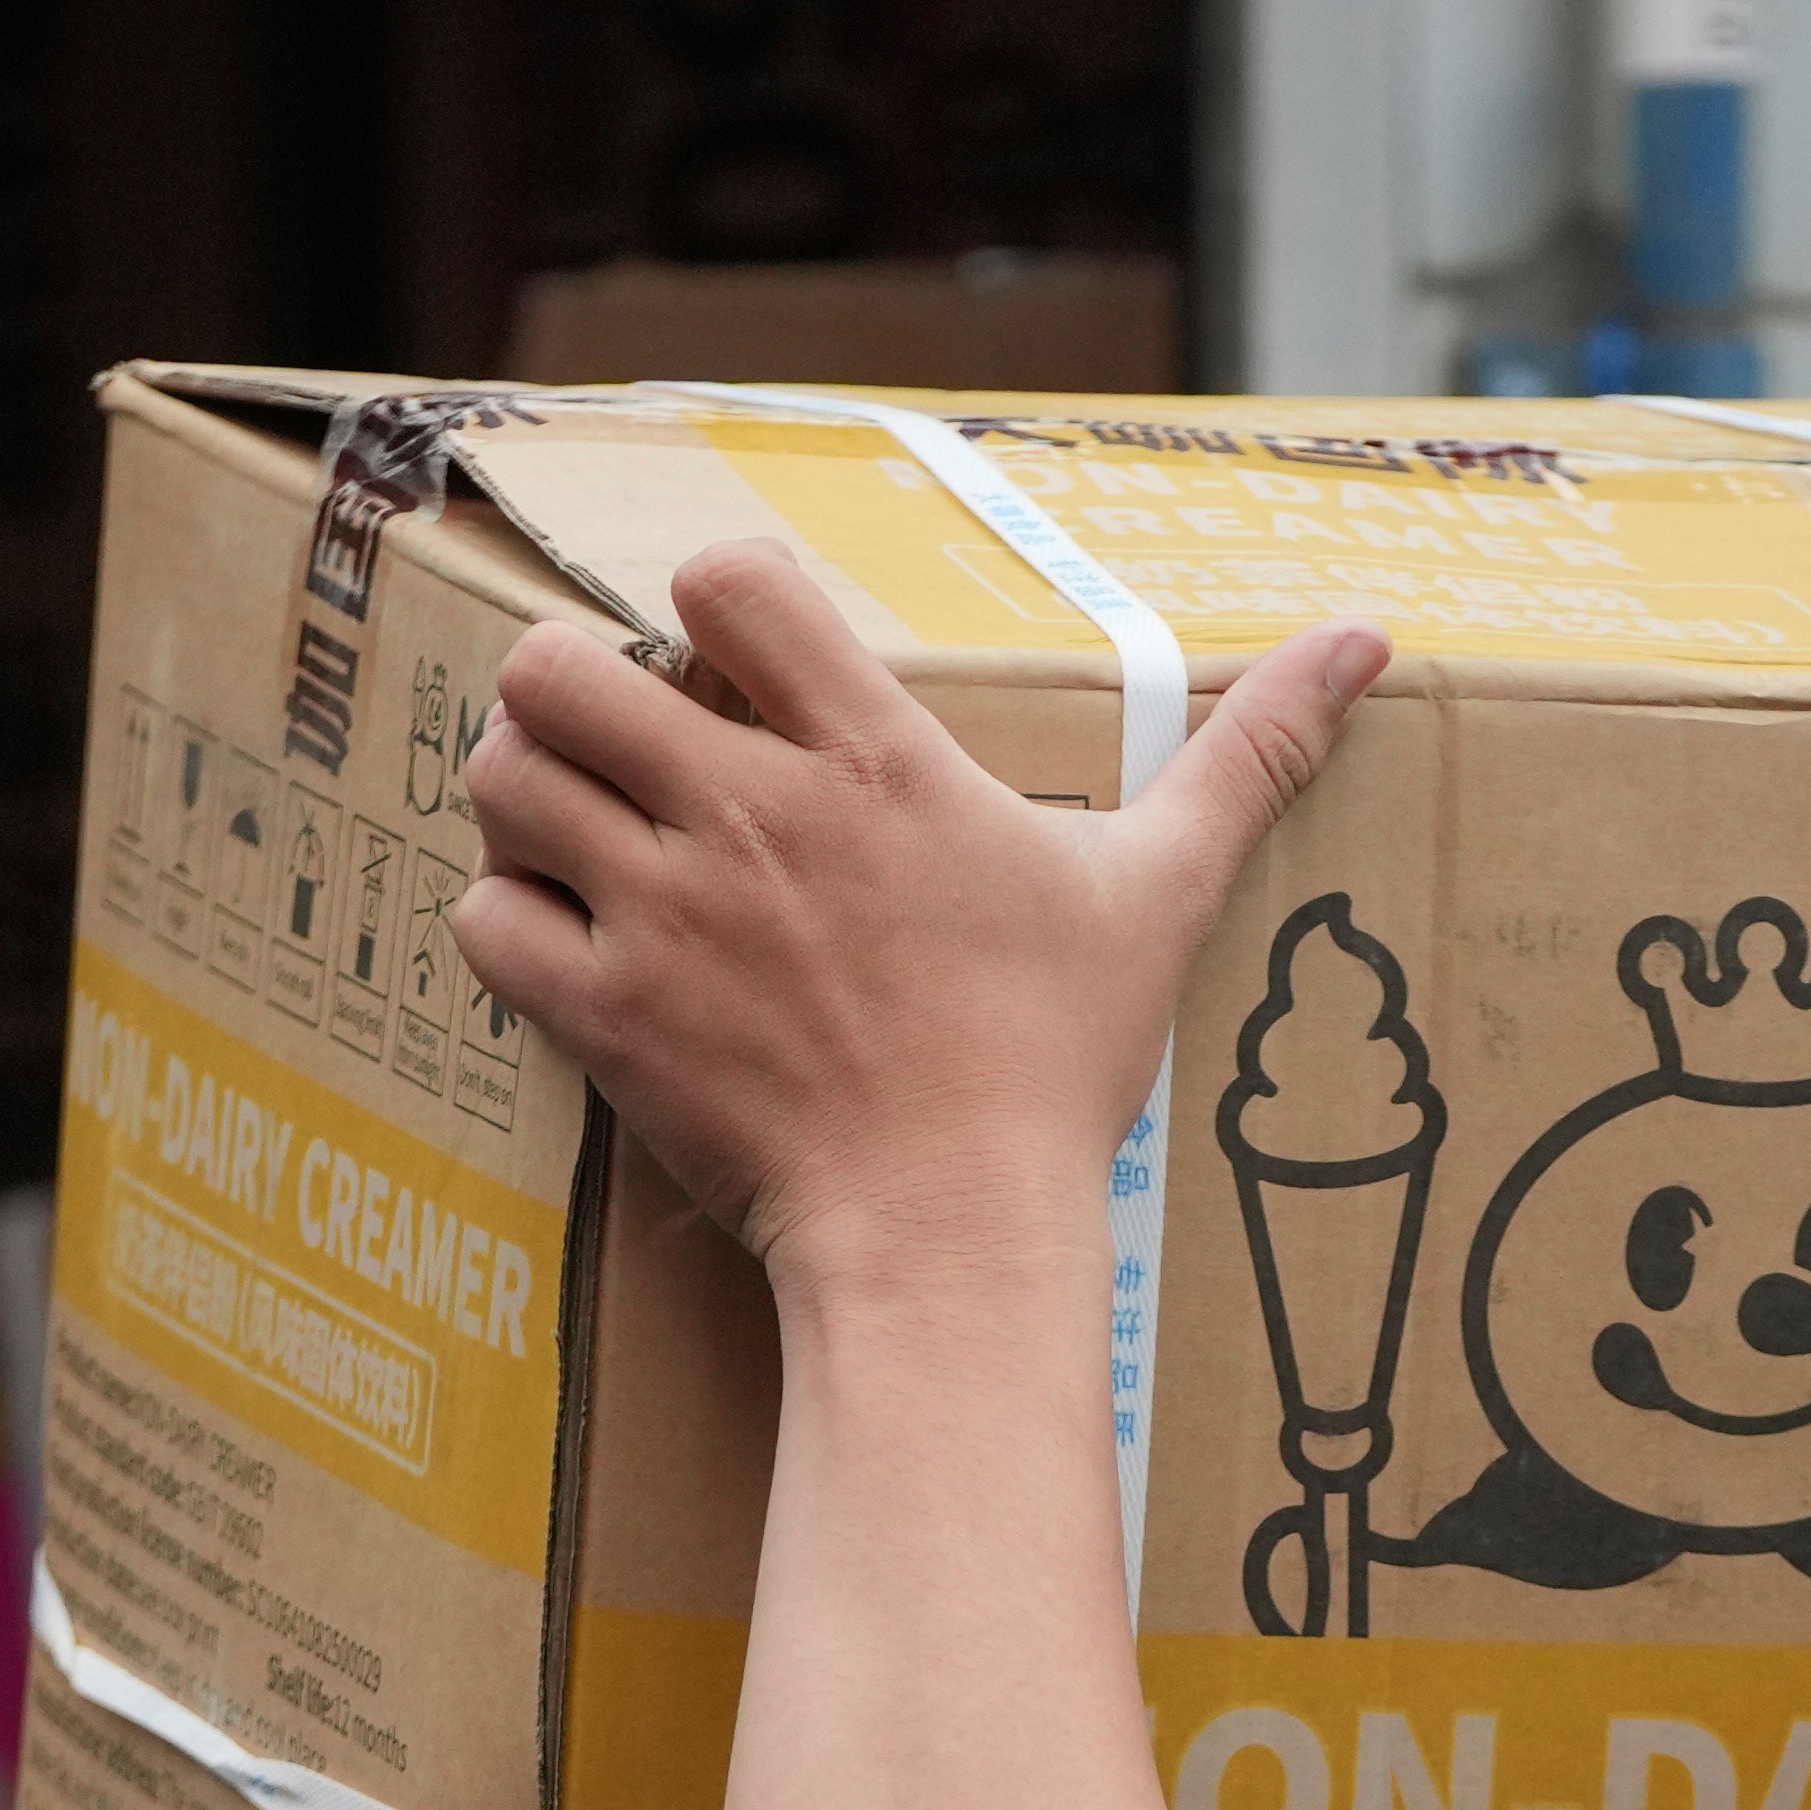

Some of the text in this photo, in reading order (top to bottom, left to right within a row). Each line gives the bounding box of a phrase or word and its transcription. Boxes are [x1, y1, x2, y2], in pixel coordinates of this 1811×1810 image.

[1052, 505, 1645, 572] REAMER
[69, 990, 532, 1358] NON-DAIRY CREAMER
[352, 1713, 409, 1773] months
